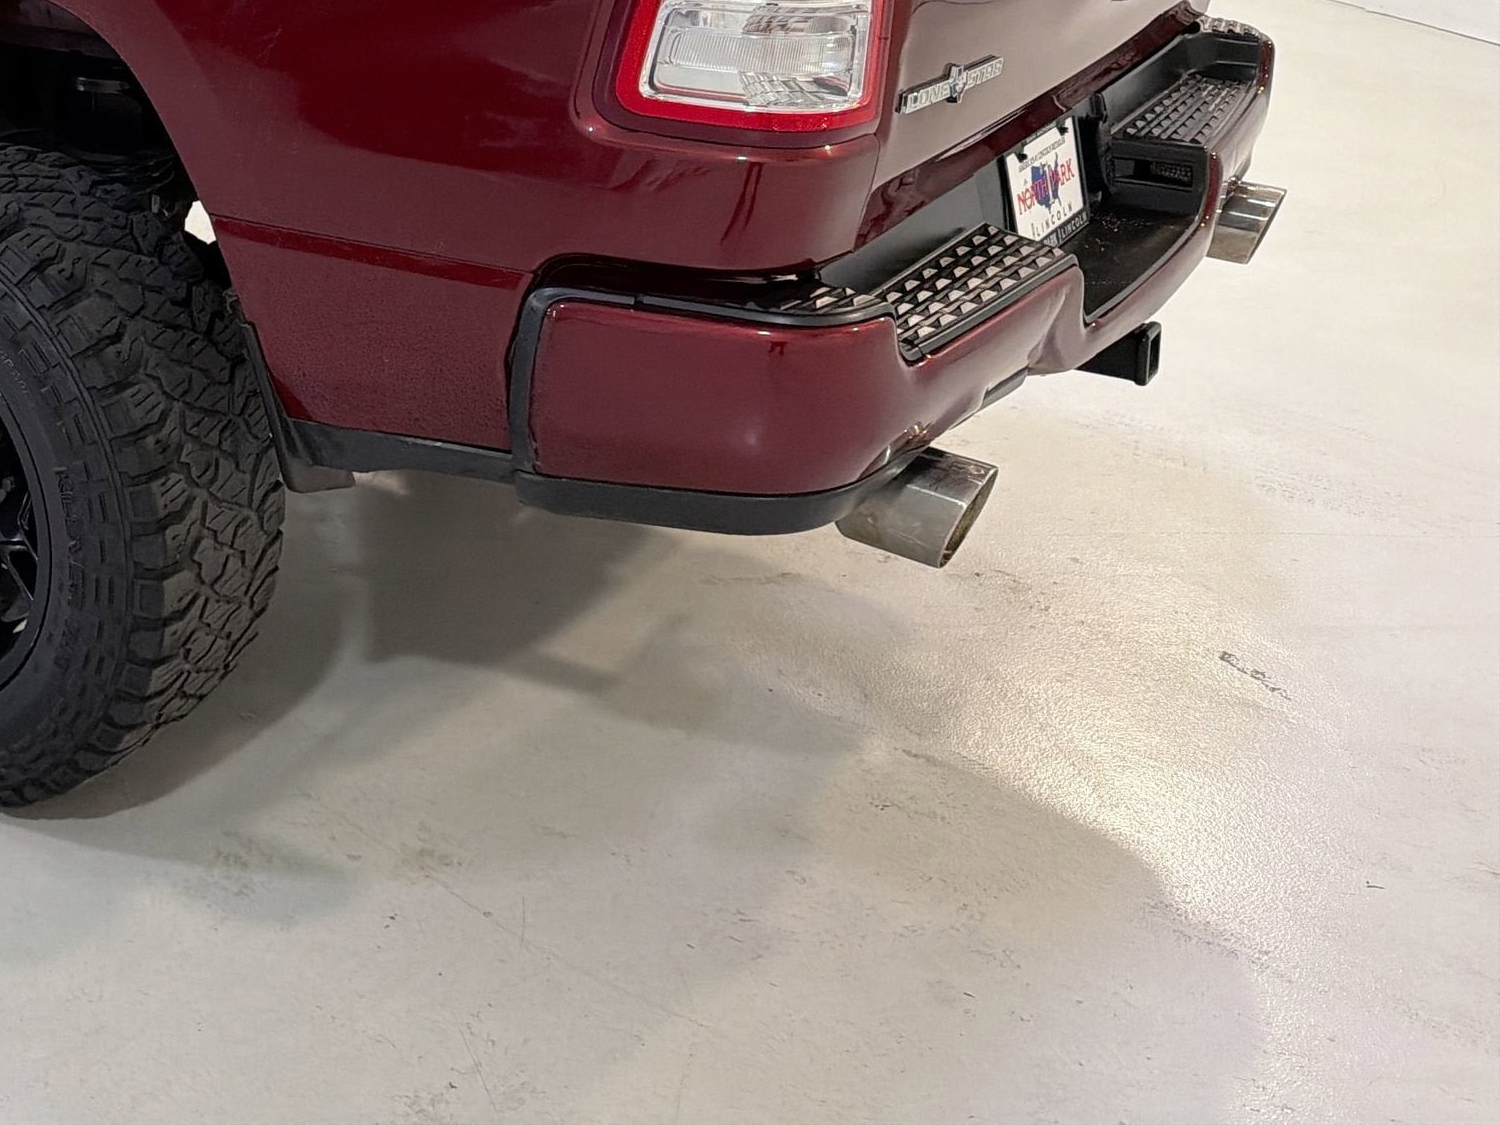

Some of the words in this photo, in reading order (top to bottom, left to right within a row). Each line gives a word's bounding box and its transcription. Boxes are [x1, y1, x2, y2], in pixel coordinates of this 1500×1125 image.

[905, 79, 951, 114] LONE
[966, 58, 1003, 88] STAR
[1049, 158, 1075, 188] PARK
[1035, 201, 1073, 238] LINCOLN
[1060, 211, 1088, 241] LINCOLN
